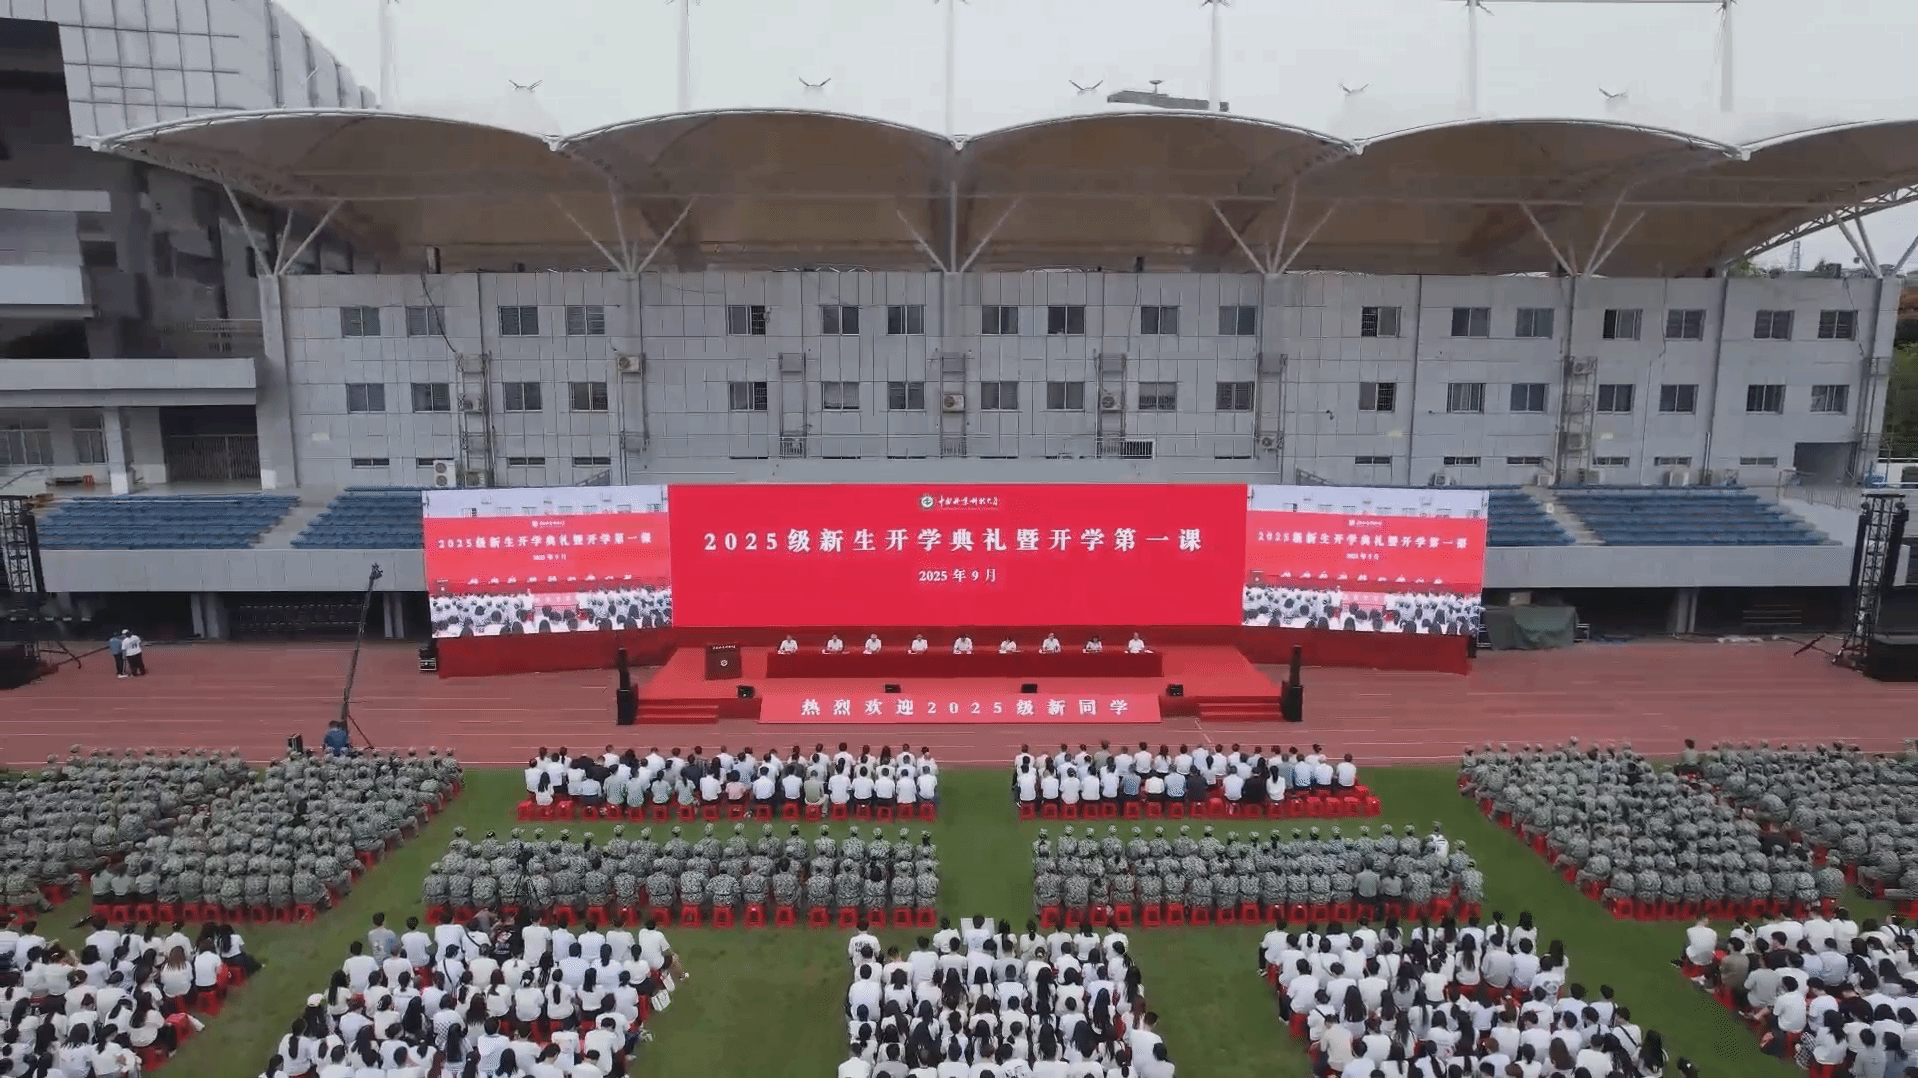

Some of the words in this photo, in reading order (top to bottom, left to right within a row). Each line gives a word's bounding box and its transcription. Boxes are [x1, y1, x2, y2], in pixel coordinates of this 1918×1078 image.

[704, 527, 1203, 553] 2025级新生开学典礼暨开学第一课
[801, 698, 1129, 716] 热烈欢迎2025级新同学
